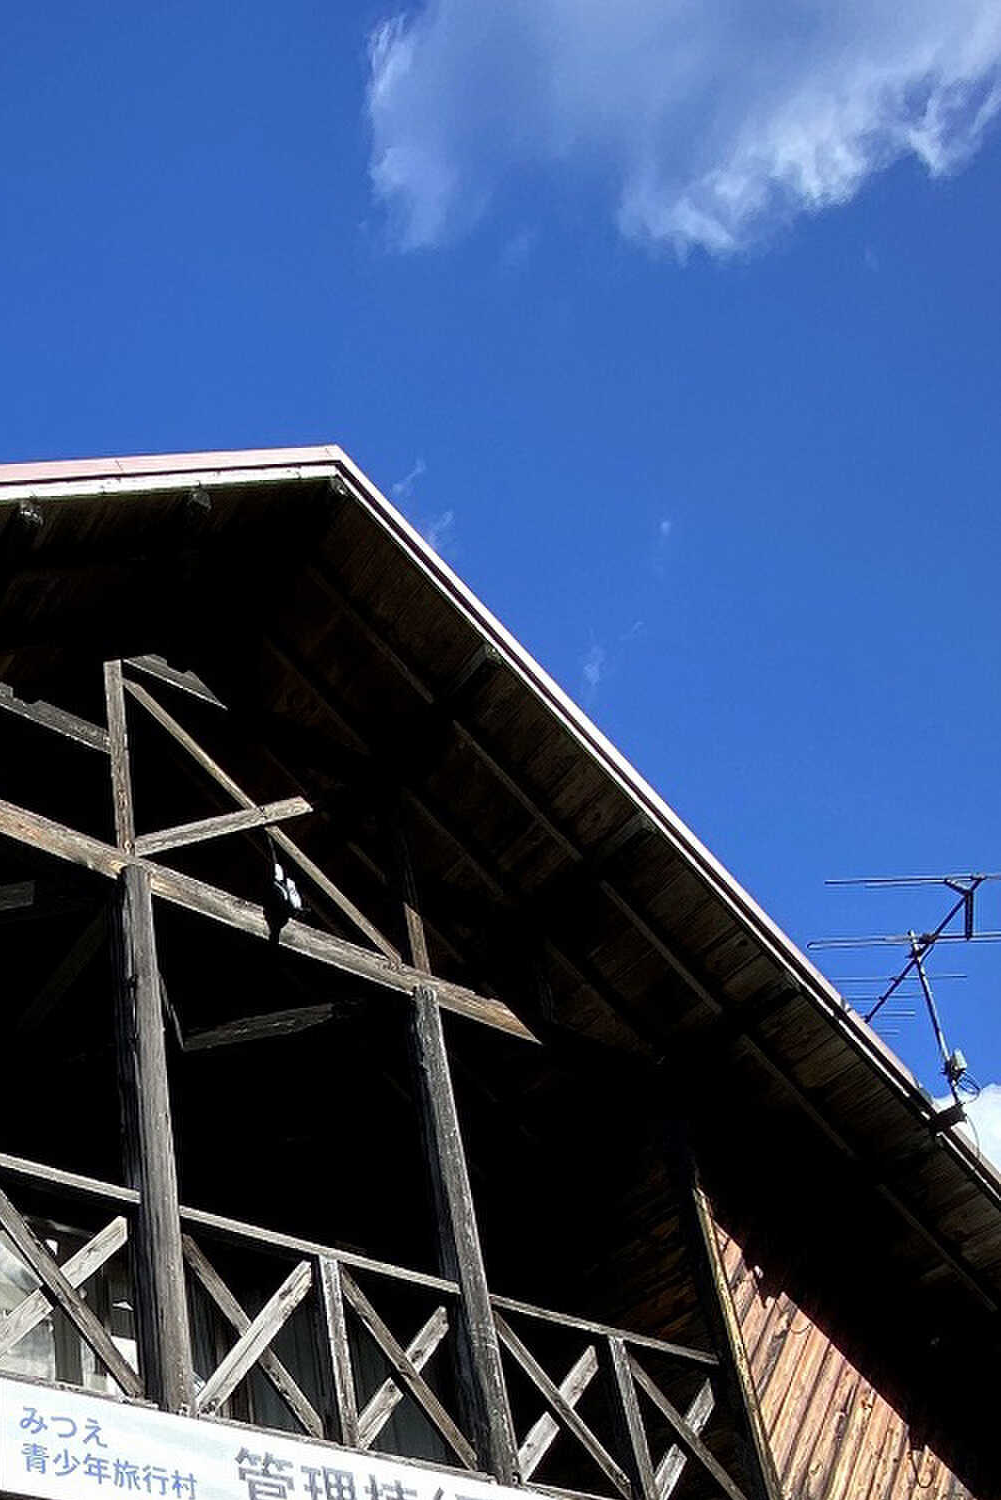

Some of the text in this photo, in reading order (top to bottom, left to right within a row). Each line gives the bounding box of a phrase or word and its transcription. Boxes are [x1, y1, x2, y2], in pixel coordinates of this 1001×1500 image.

[20, 1405, 108, 1448] みつえ
[21, 1443, 198, 1500] 青少年旅行村
